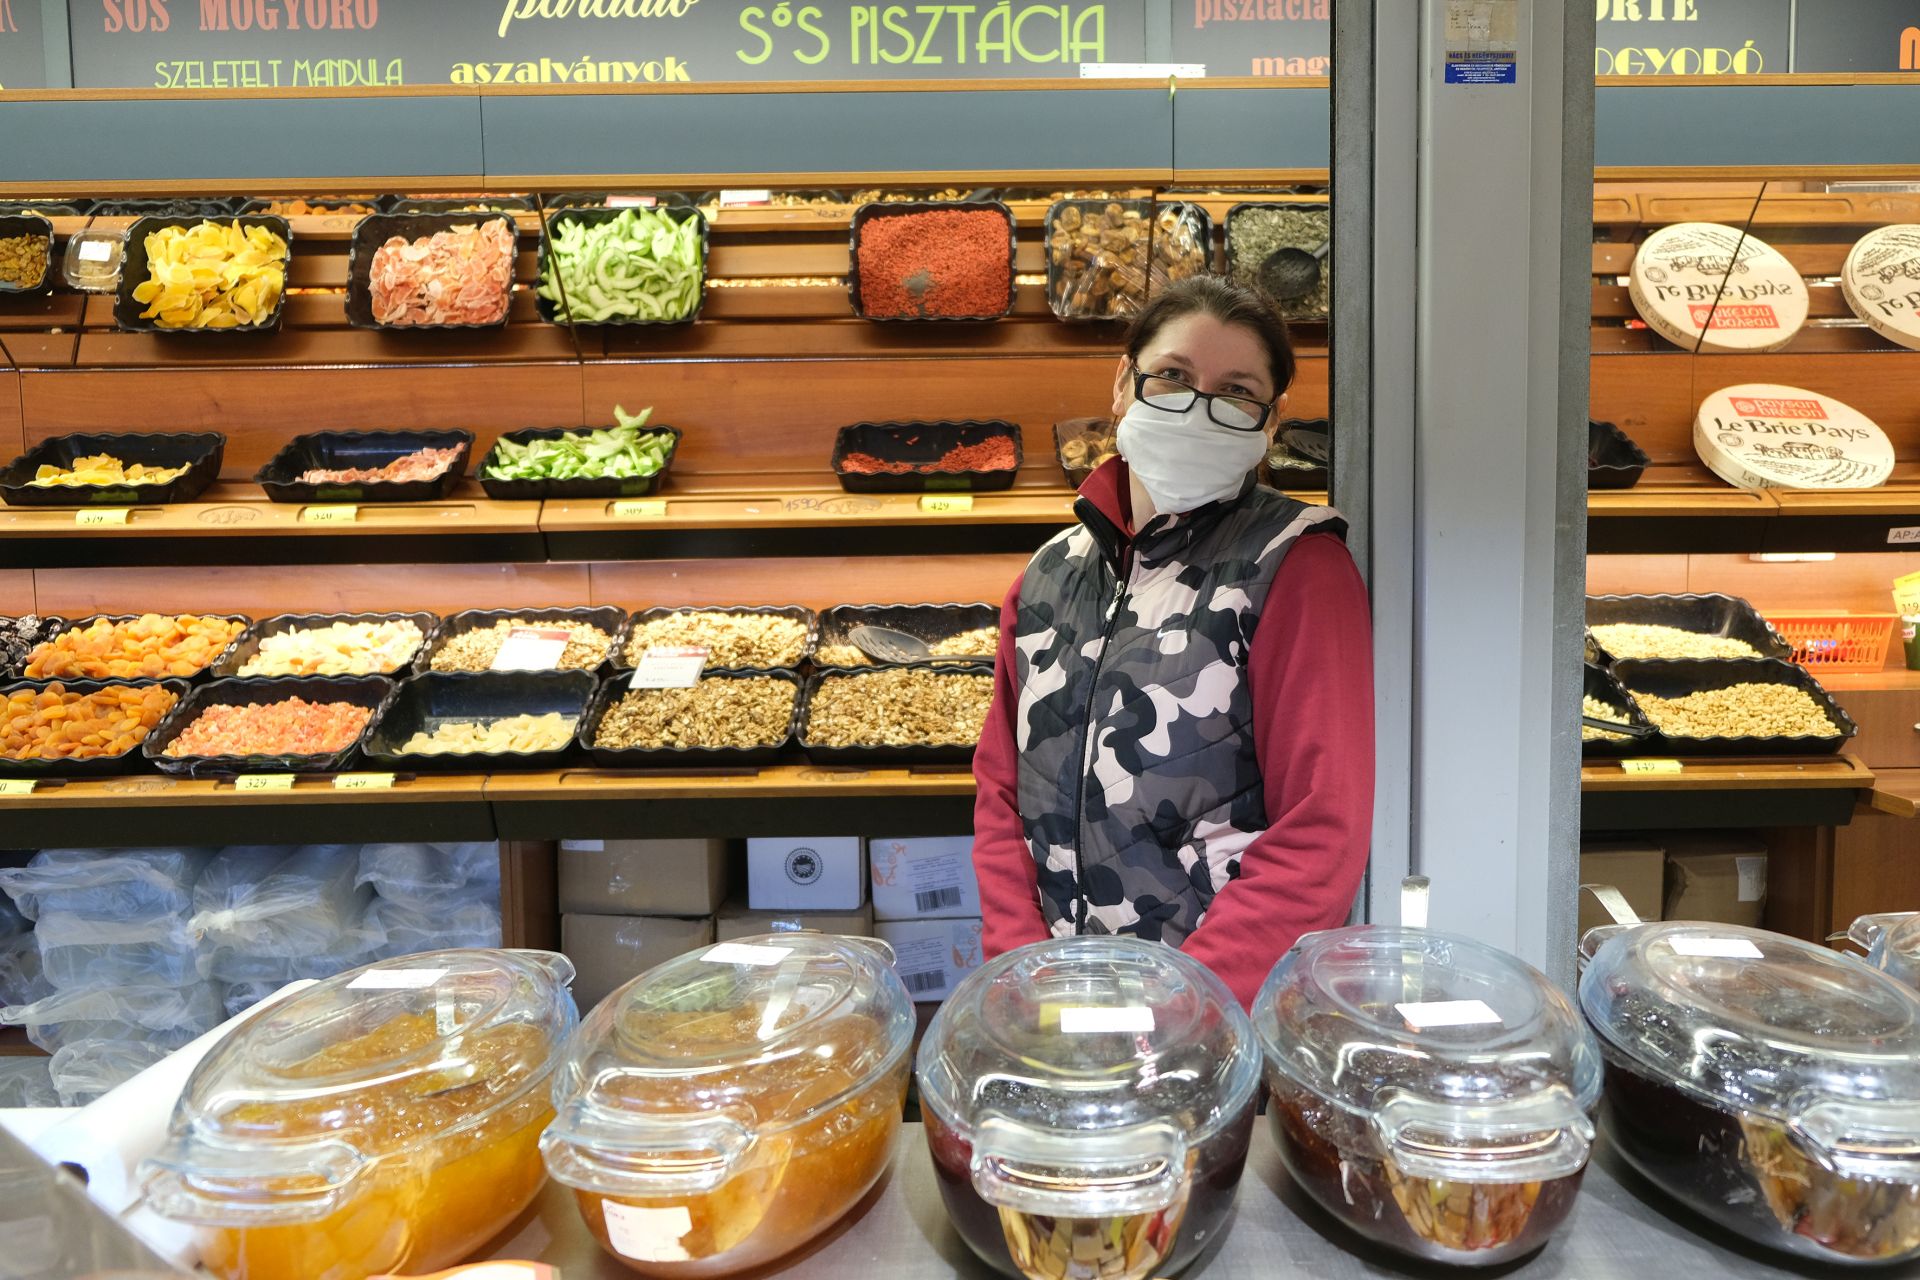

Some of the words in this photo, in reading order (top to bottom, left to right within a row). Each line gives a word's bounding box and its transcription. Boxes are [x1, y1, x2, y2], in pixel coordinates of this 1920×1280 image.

[735, 1, 830, 65] SÓS
[850, 0, 1105, 65] PISZTÁCIA
[154, 60, 283, 89] SZELETELT
[292, 58, 403, 87] MANDULA
[450, 55, 691, 83] aszalványok
[1714, 417, 1743, 432] Le
[1744, 419, 1802, 436] Brie
[1803, 422, 1870, 442] Pays
